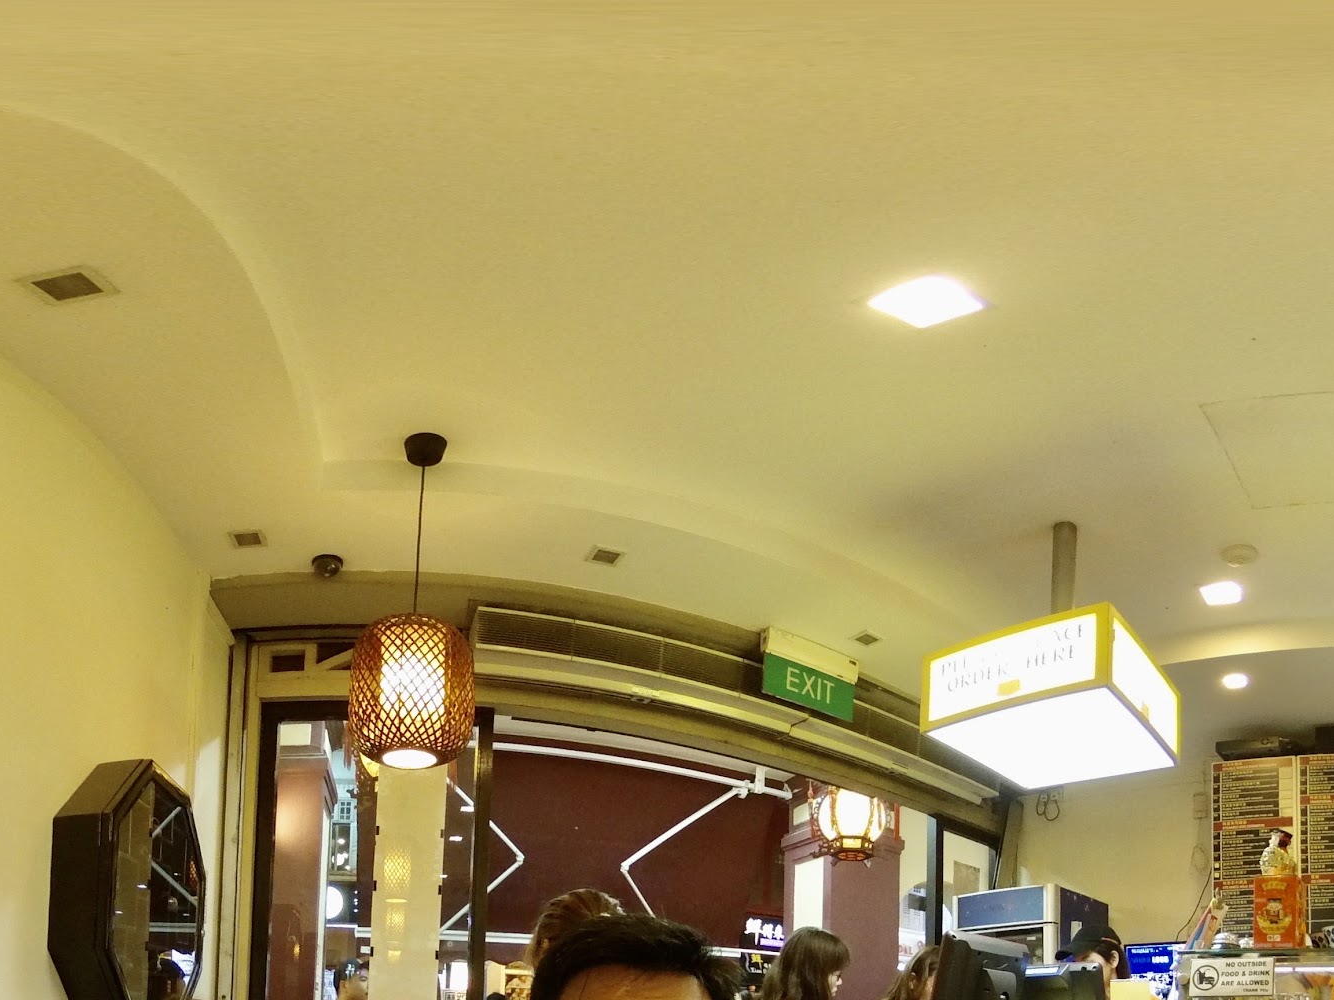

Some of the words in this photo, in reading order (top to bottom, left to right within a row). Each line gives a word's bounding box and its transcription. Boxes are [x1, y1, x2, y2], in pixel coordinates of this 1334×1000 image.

[785, 665, 836, 706] EXIT
[947, 663, 1008, 692] ORDER
[1026, 644, 1075, 669] HERE
